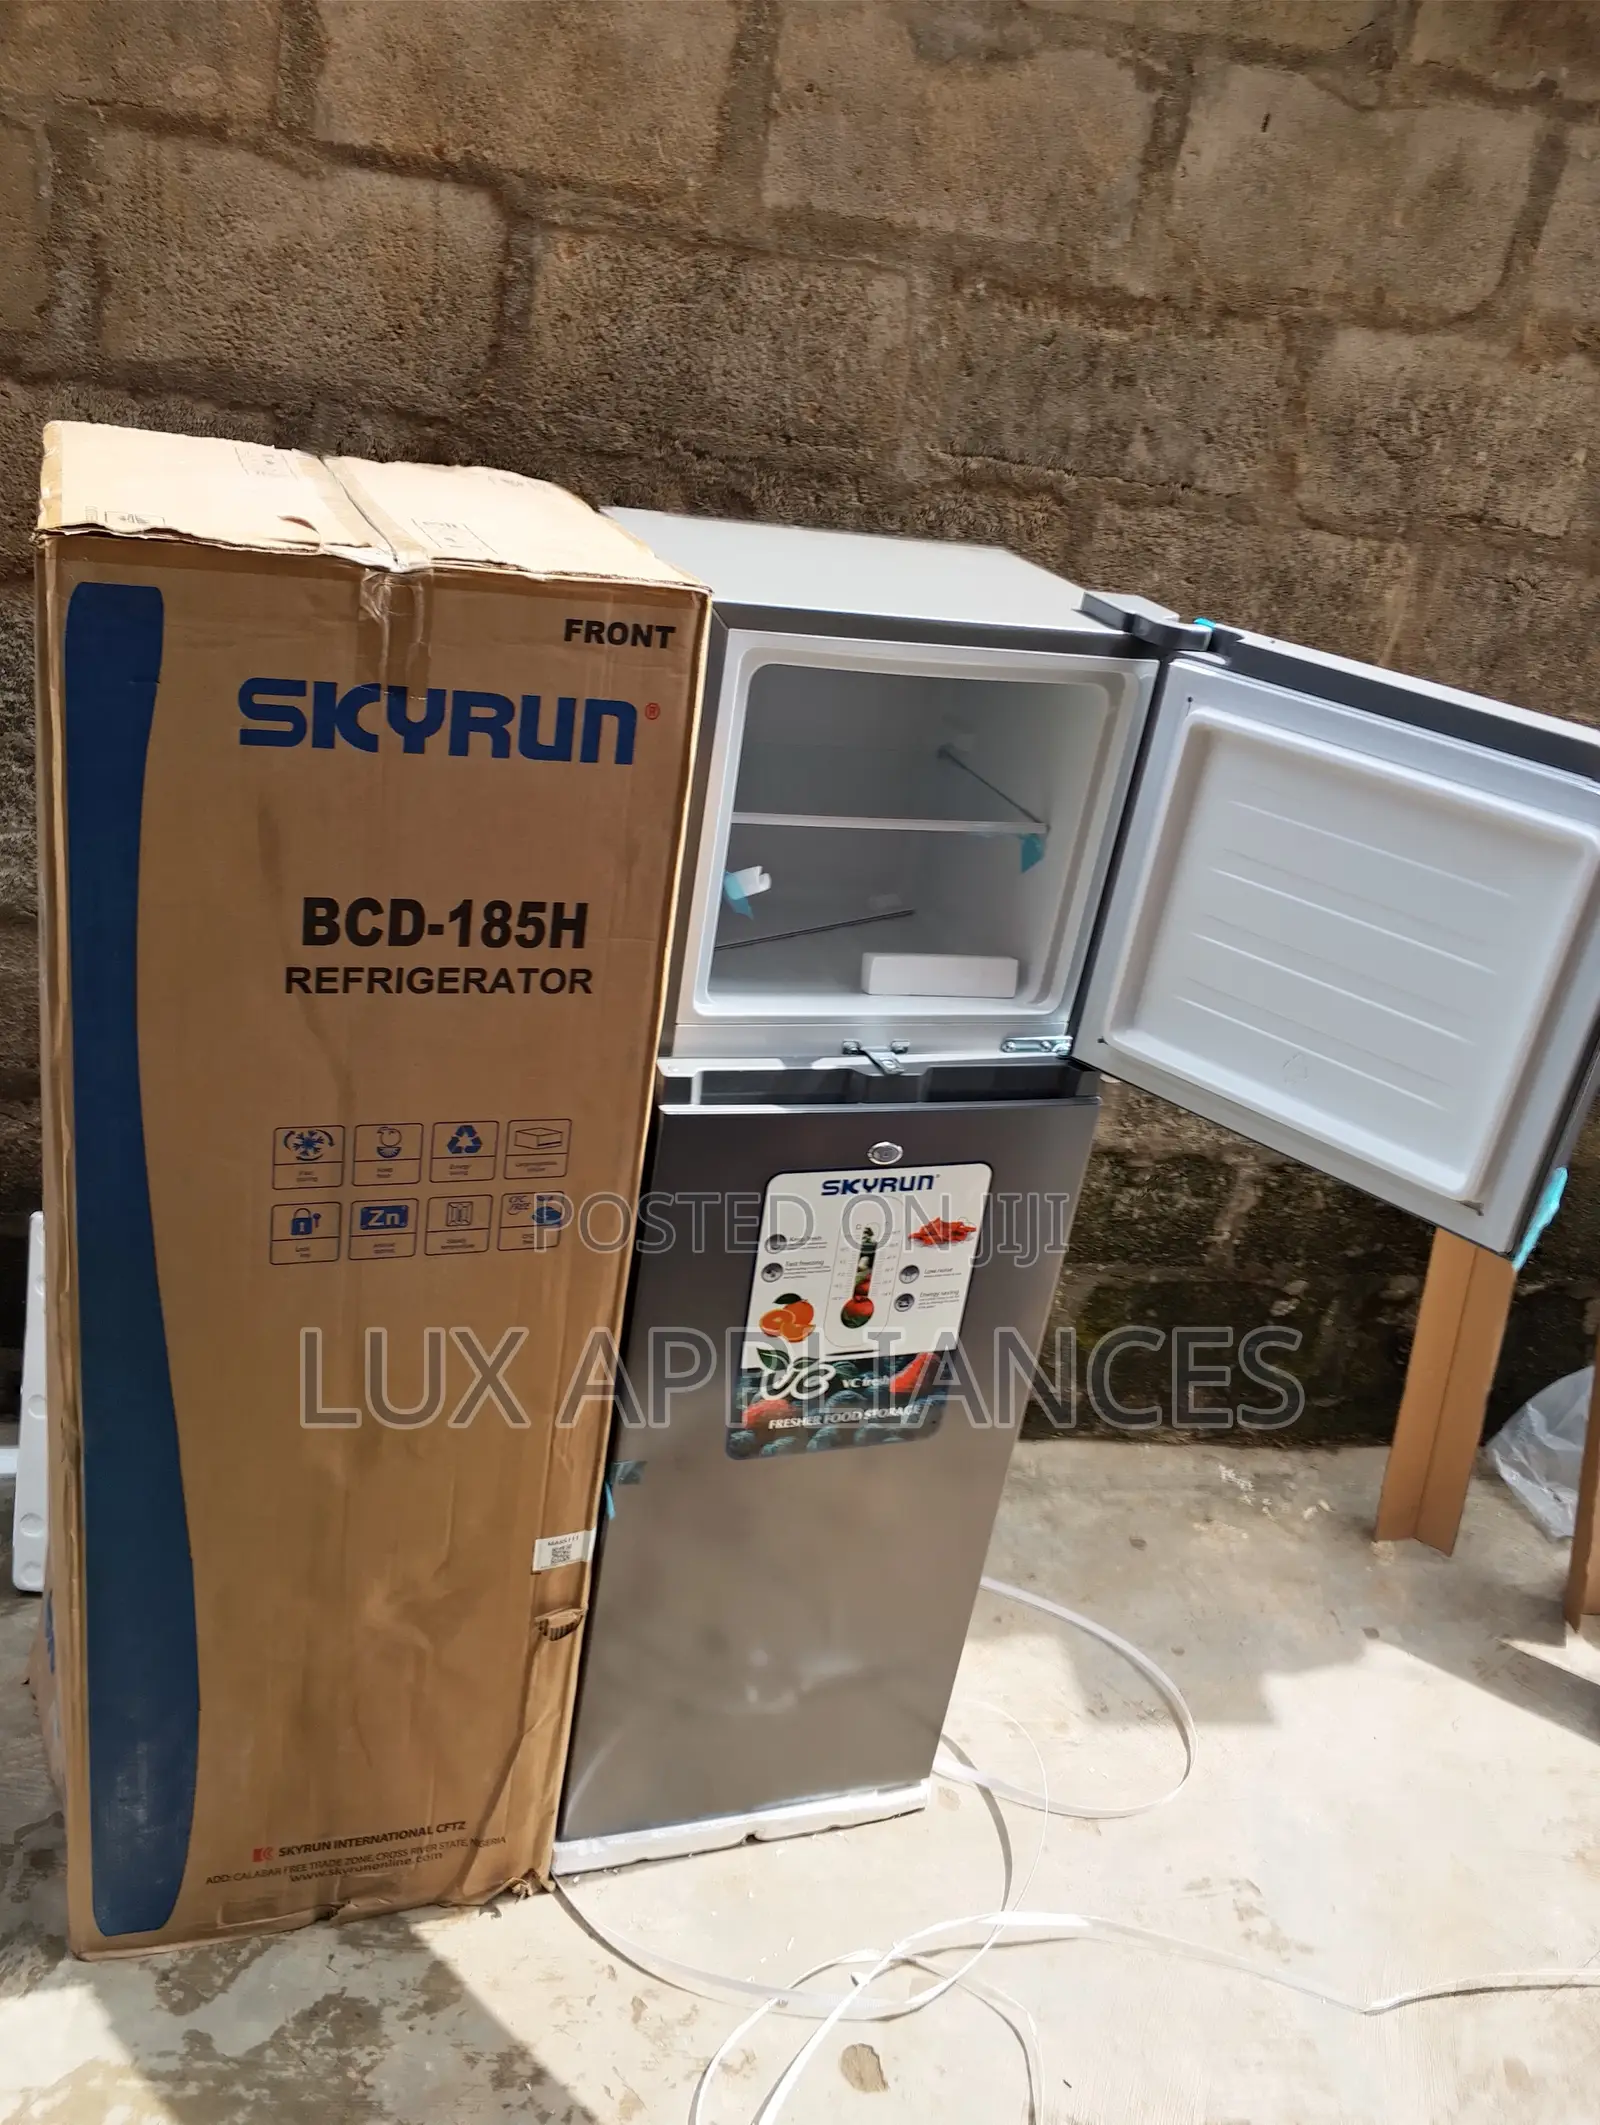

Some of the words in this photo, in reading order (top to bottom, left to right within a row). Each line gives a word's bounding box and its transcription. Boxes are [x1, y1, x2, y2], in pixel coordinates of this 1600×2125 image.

[563, 618, 676, 649] FRONT
[238, 677, 638, 765] SKYRUN
[302, 897, 589, 949] BCD-185H
[285, 966, 593, 994] REFRIGERATOR
[821, 1174, 935, 1196] SKYRUN
[369, 1209, 400, 1226] Zn
[768, 1414, 822, 1430] FRESHER
[824, 1410, 862, 1424] FOOD
[863, 1405, 921, 1420] STORAGE
[278, 1840, 332, 1857] SKYRUN
[333, 1825, 434, 1849] INTERNATIONAL
[436, 1821, 466, 1834] CFTZ
[233, 1867, 281, 1881] CALABAR
[283, 1863, 308, 1875] FREE
[310, 1857, 342, 1871] TRADE
[375, 1848, 409, 1861] CROSS
[410, 1844, 440, 1856] RIVER
